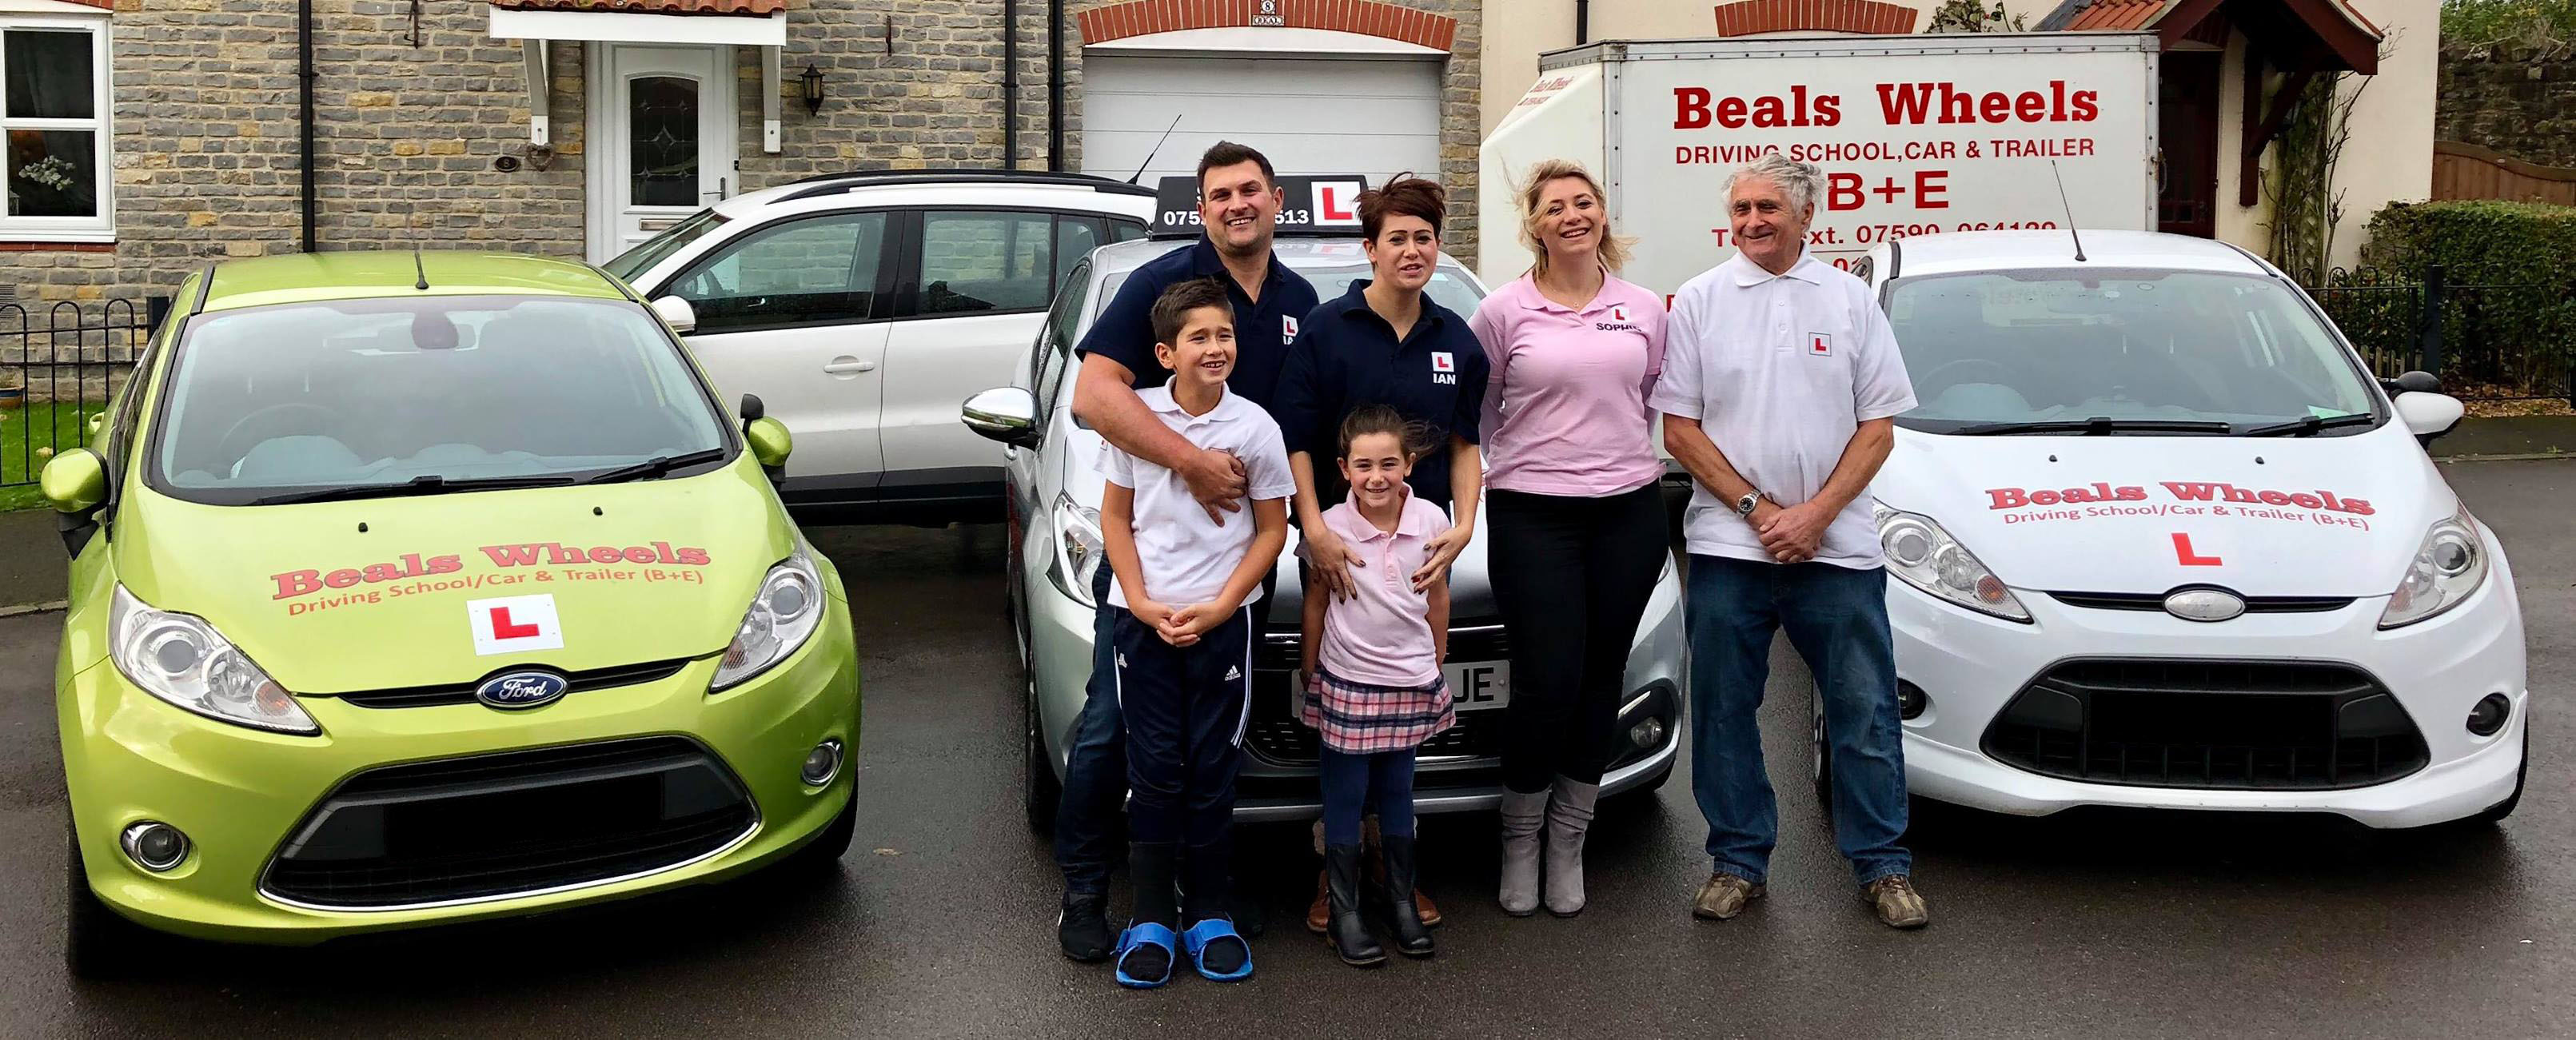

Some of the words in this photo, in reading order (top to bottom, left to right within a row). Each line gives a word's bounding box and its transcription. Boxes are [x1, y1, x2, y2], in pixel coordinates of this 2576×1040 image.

[1265, 2, 1270, 10] 8
[1673, 85, 1841, 130] Beals
[1876, 80, 2099, 125] Wheels
[1965, 141, 1981, 159] &
[1990, 138, 2094, 157] TRAILER
[1828, 170, 1949, 211] B+E
[1322, 187, 1353, 220] L
[1163, 210, 1206, 225] 075
[1615, 309, 1625, 321] L
[1286, 321, 1295, 333] L
[1282, 336, 1294, 345] IA
[1815, 338, 1826, 351] L
[1437, 357, 1449, 368] L
[1433, 373, 1456, 385] IAN
[1985, 482, 2148, 510] Beals
[2159, 481, 2376, 516] Wheels
[2004, 510, 2081, 524] Driving
[2086, 504, 2205, 517] School/Car
[2213, 504, 2231, 516] &
[2235, 506, 2305, 521] Trailer
[2312, 513, 2369, 532] (B+E)
[2171, 532, 2223, 566] L
[270, 553, 464, 600] Beals
[479, 541, 712, 568] Wheels
[289, 591, 382, 616] Driving
[389, 574, 527, 597] School/Car
[535, 571, 554, 583] &
[562, 568, 636, 581] Trailer
[644, 568, 704, 585] (B+E)
[489, 606, 540, 640] L
[498, 678, 548, 699] Ford
